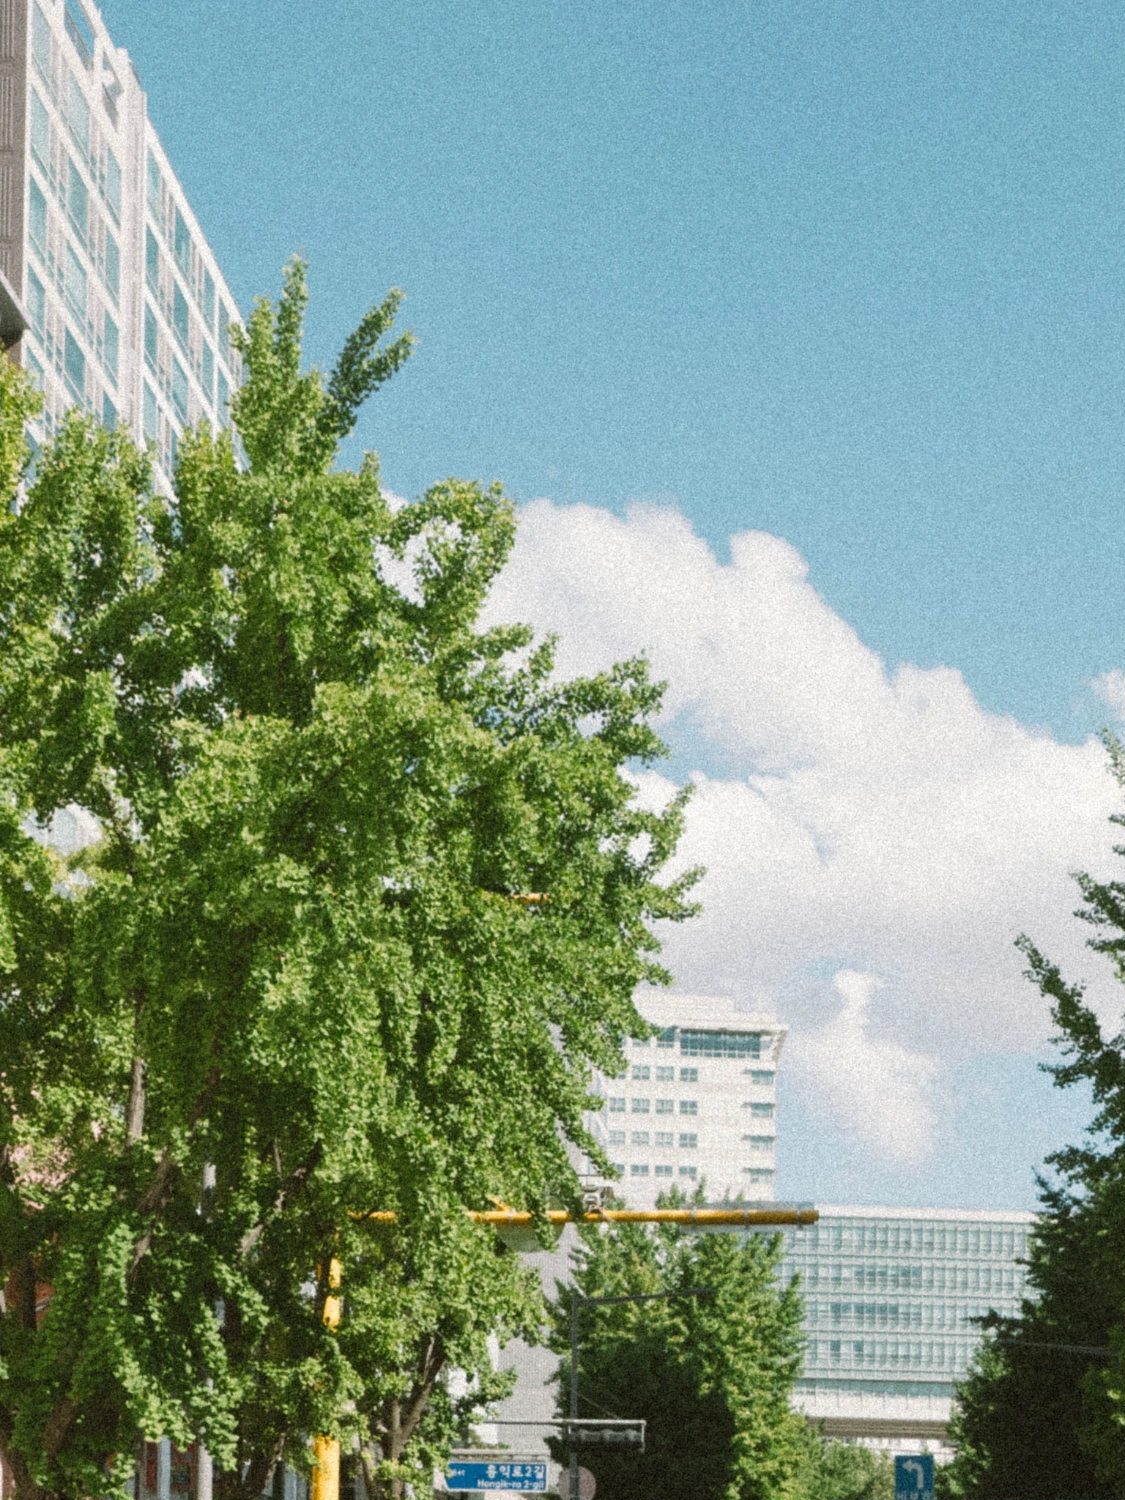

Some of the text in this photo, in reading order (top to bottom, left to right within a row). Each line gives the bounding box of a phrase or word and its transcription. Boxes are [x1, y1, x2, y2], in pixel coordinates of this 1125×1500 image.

[487, 1464, 544, 1479] 홍익로2길
[478, 1480, 544, 1490] Hongik-ro 2-gil
